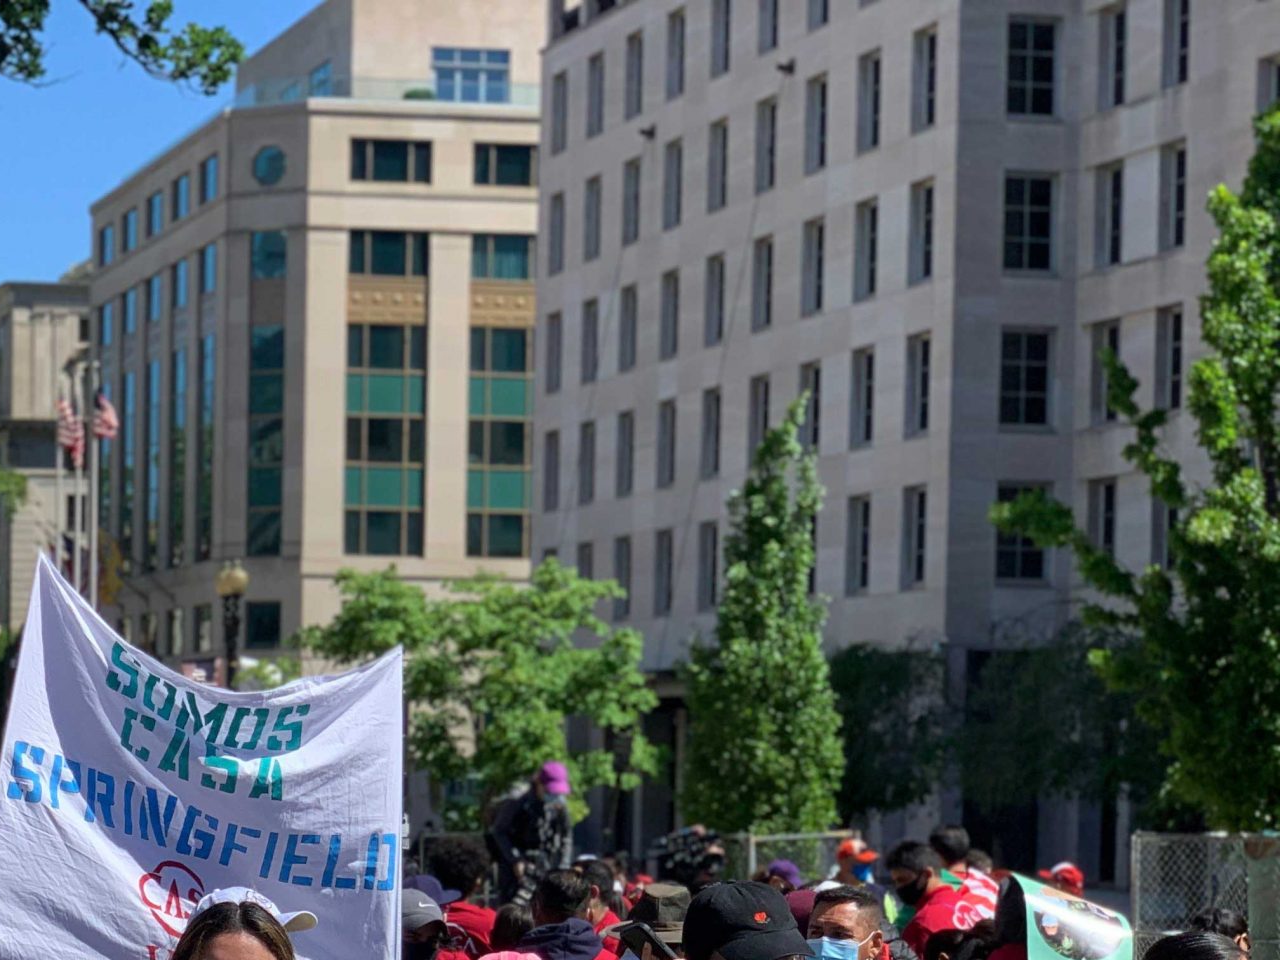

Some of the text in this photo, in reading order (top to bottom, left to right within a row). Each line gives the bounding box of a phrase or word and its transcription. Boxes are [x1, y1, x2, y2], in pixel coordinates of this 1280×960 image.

[105, 641, 310, 751] SOMOS
[120, 707, 284, 801] CASA
[6, 740, 396, 891] SPRINGFIELD
